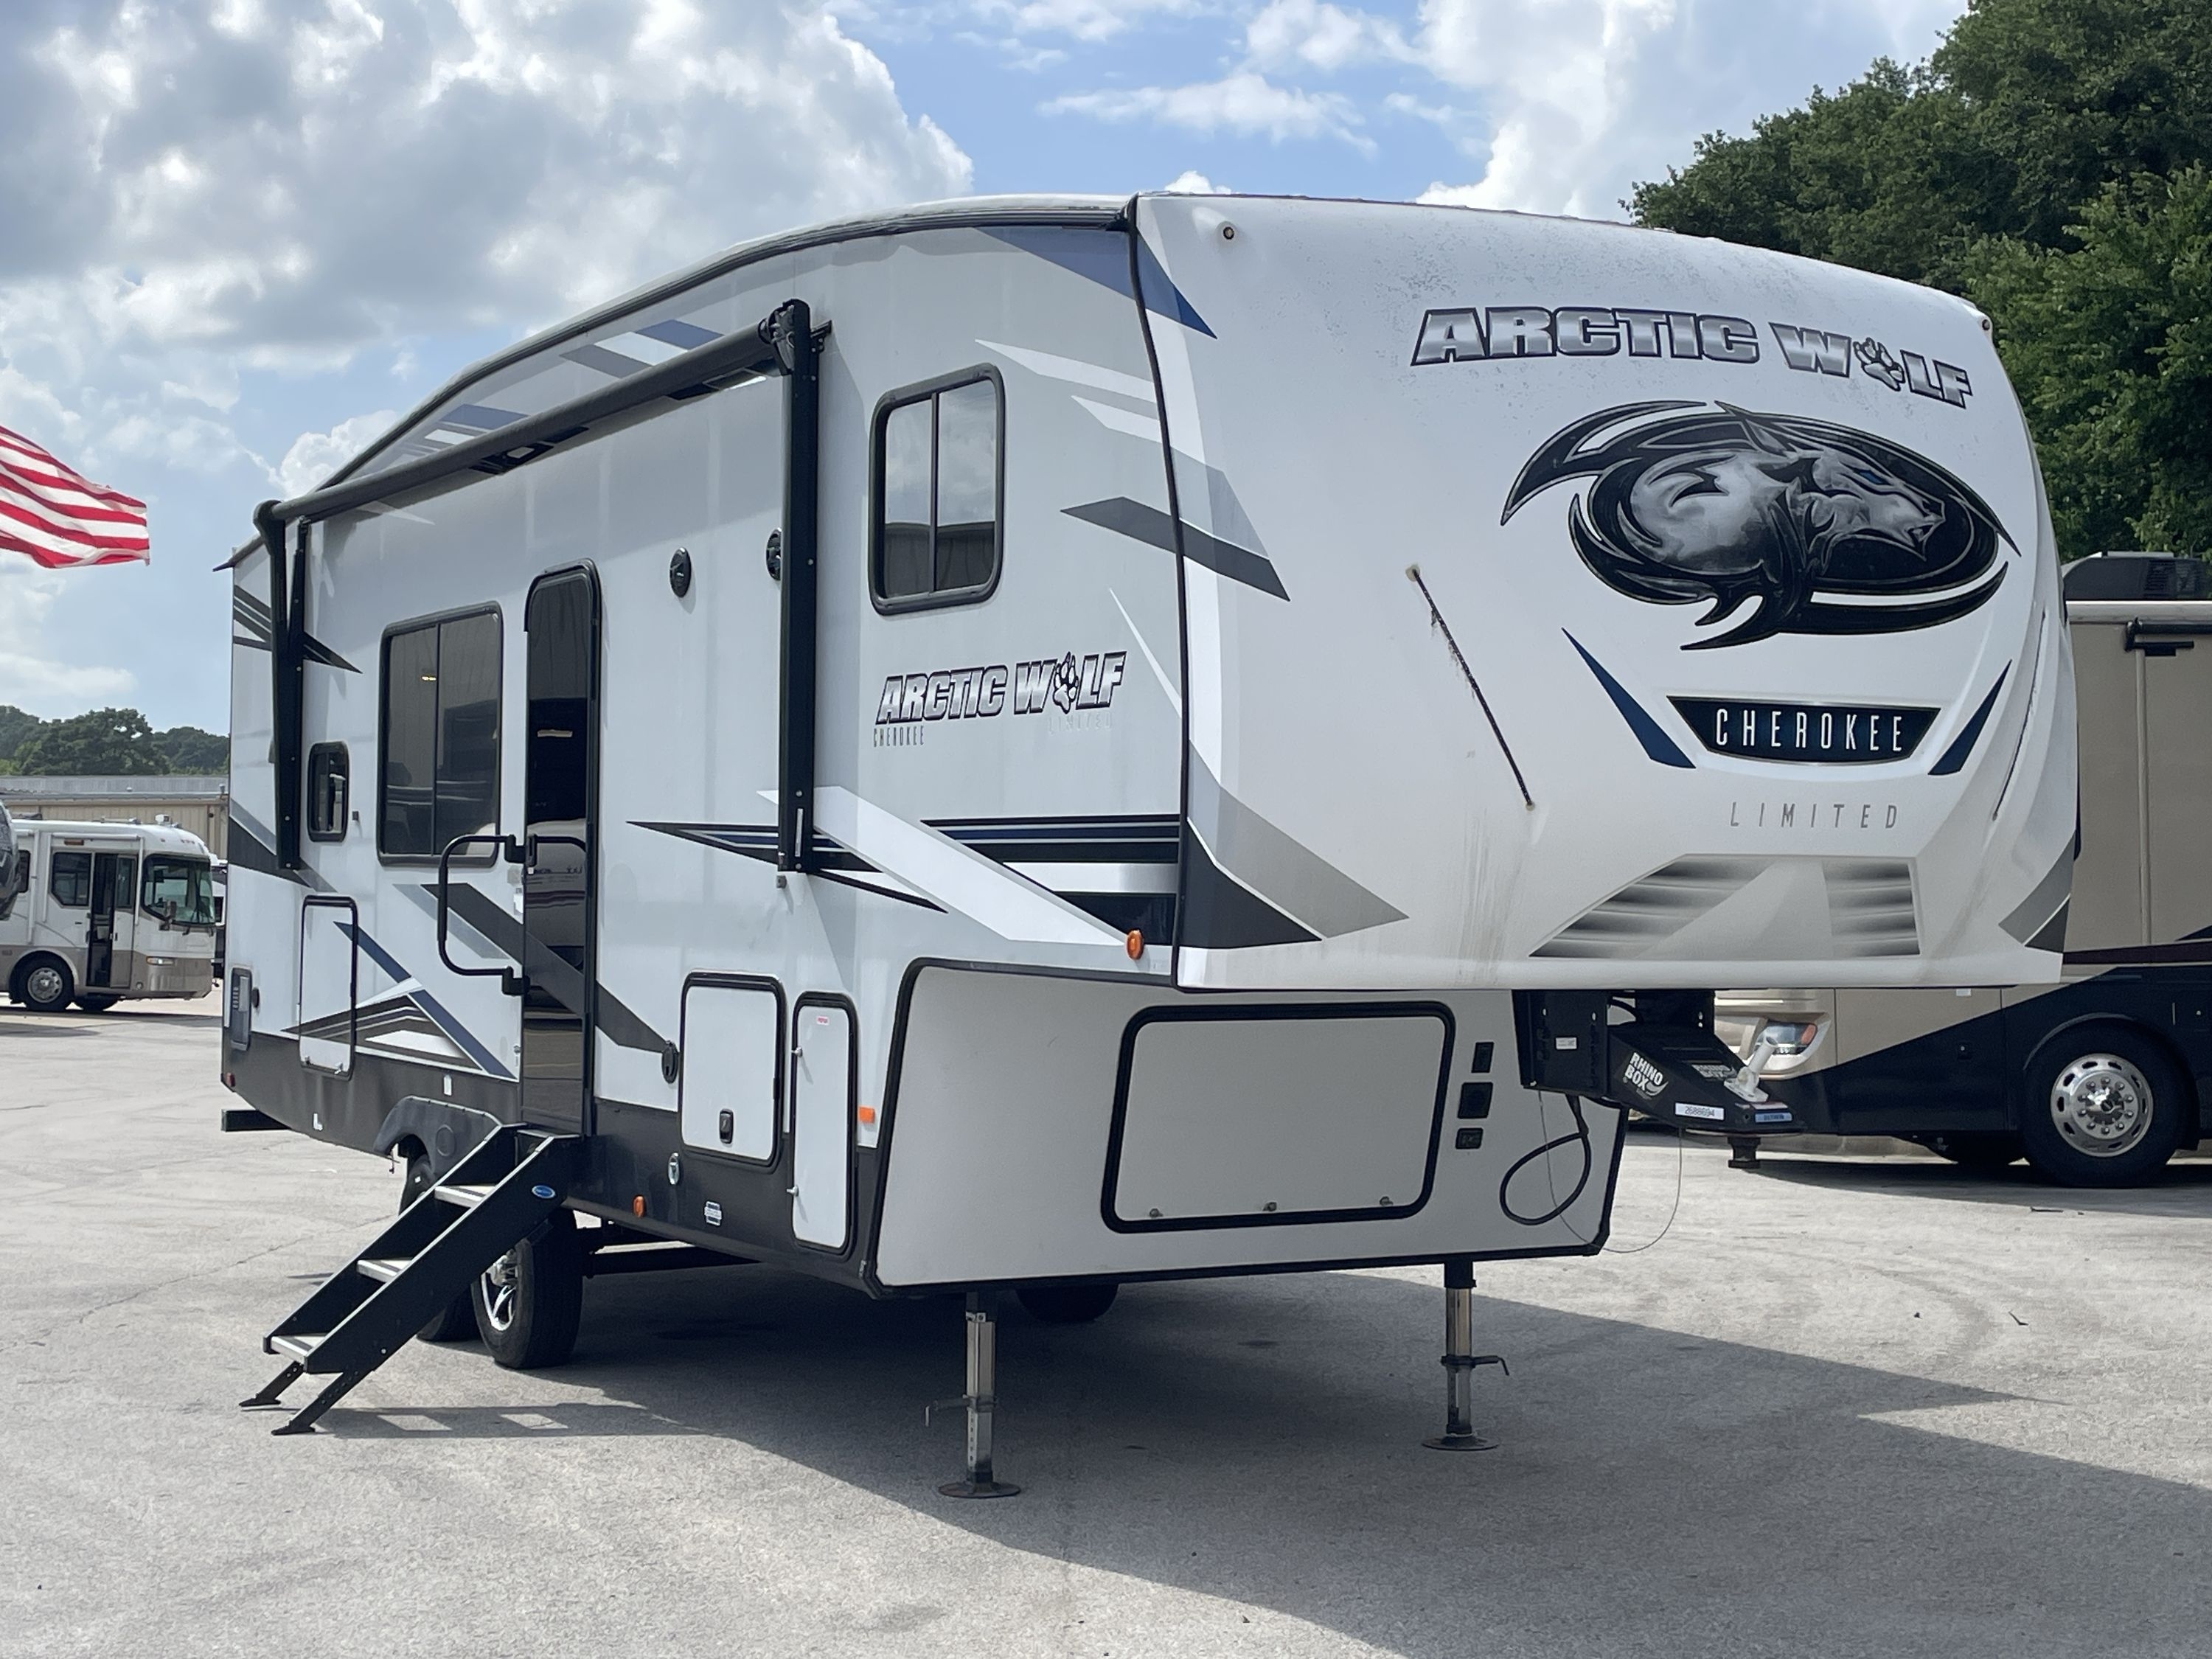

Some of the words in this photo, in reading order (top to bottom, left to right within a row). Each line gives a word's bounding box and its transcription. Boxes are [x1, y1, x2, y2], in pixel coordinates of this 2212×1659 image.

[1410, 306, 1760, 366] ARCTIC
[875, 664, 1009, 725] ARCTIC
[873, 726, 924, 748] CHEROKEE
[1716, 709, 1902, 751] CHEROKEE
[1731, 801, 1897, 829] LIMITED
[1625, 1064, 1649, 1091] BOX
[1630, 1052, 1663, 1085] RHINO
